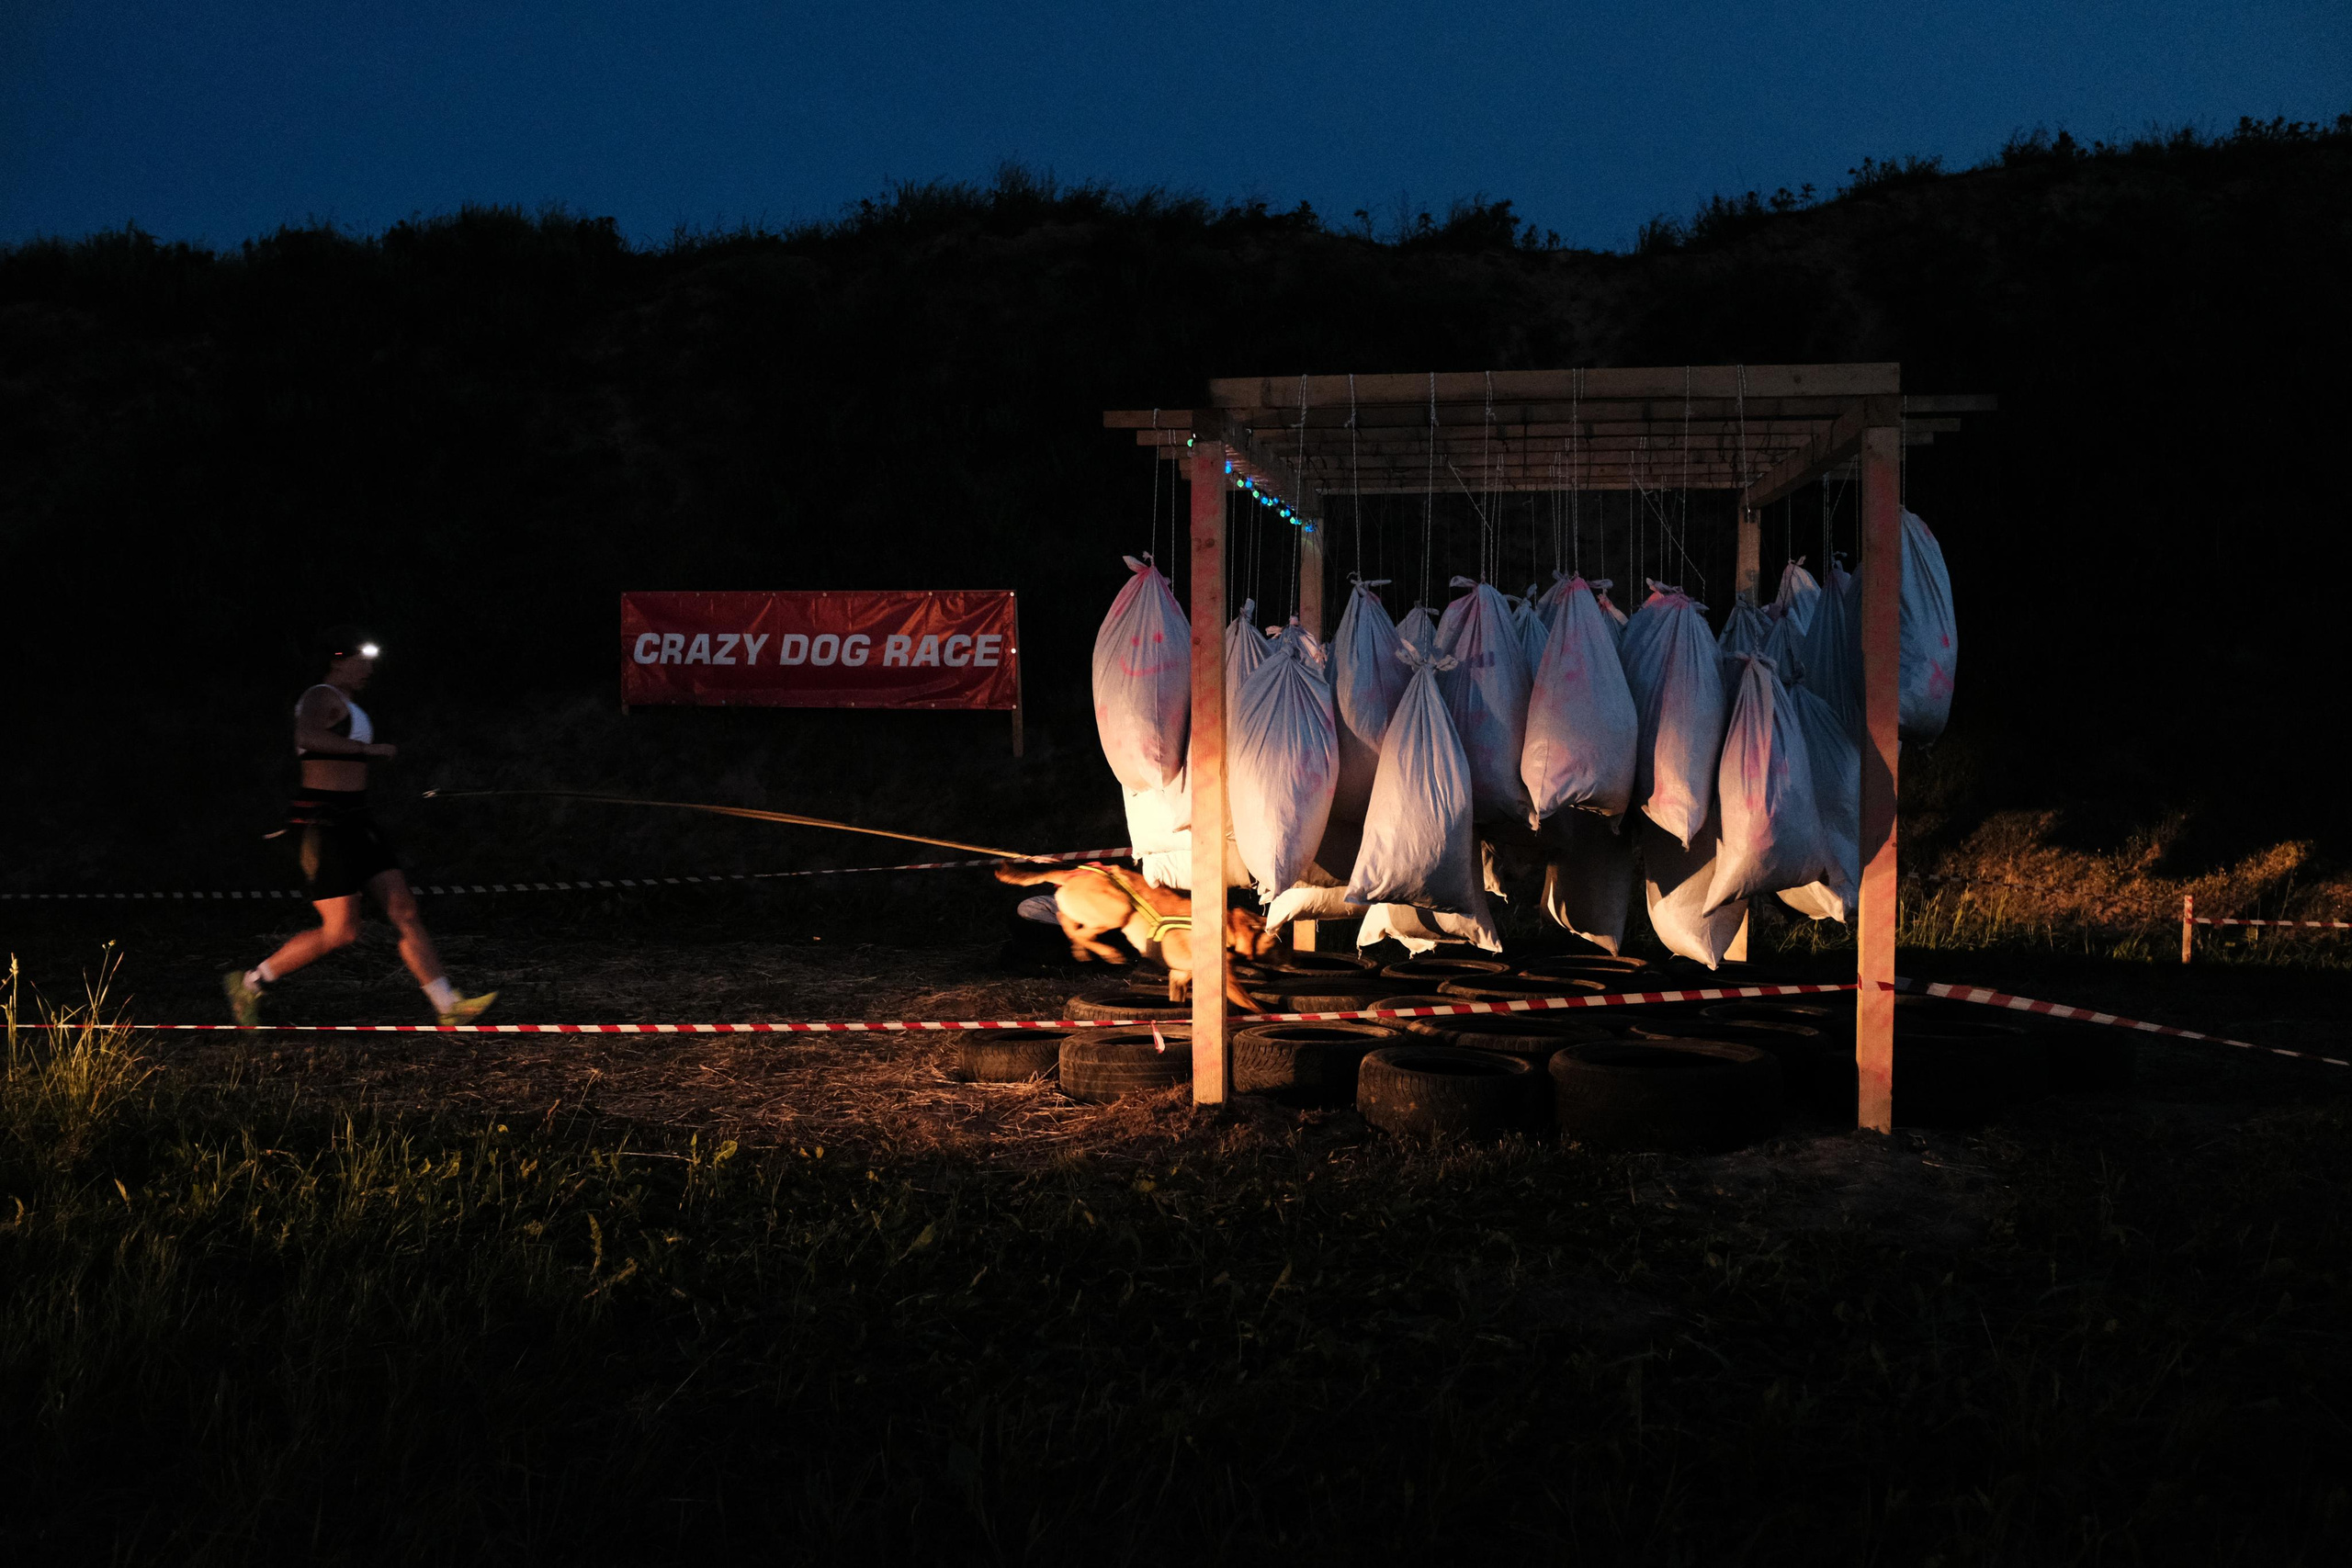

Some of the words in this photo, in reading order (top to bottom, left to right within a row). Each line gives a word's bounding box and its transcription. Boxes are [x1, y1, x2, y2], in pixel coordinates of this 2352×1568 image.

[633, 633, 770, 666] CRAZY
[779, 634, 872, 667] DOG
[882, 634, 1003, 668] RACE
